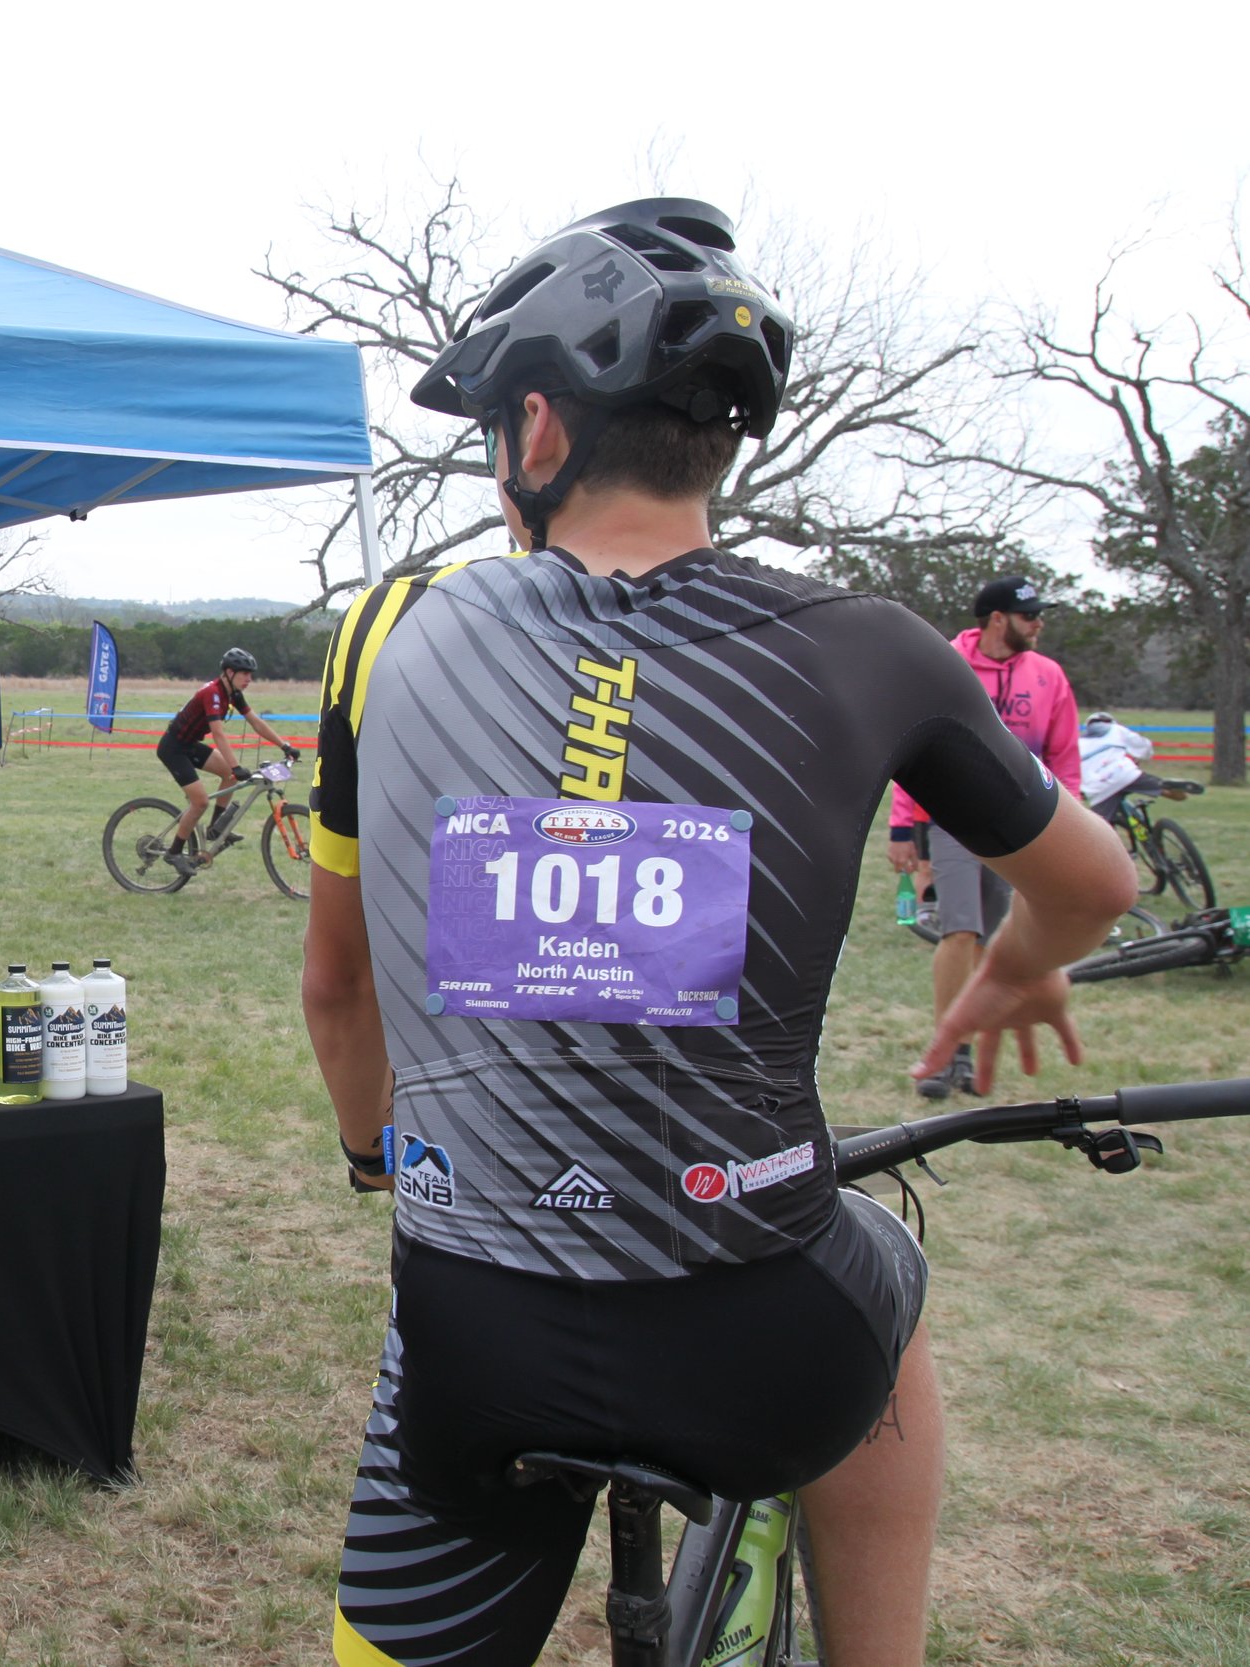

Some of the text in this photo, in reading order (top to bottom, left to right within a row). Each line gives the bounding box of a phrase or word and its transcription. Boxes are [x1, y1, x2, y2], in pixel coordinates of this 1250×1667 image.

[558, 655, 637, 803] T-HA
[446, 813, 510, 835] NICA
[548, 816, 622, 828] TEXAS
[590, 832, 616, 842] LEAGUE
[662, 820, 730, 842] 2026
[485, 851, 684, 927] 1018
[538, 936, 619, 958] Kaden
[517, 962, 634, 982] North Austin
[438, 980, 492, 992] SRAM
[512, 984, 578, 996] TREK
[465, 1000, 509, 1008] SHIMANO
[646, 1006, 692, 1016] SPECIALIZED
[8, 1025, 31, 1033] SUMMIT
[739, 1144, 812, 1180] WATKINS
[418, 1170, 450, 1186] TEAM
[744, 1170, 788, 1188] INSURANCE
[401, 1172, 452, 1206] GNB
[534, 1194, 615, 1208] AGILE
